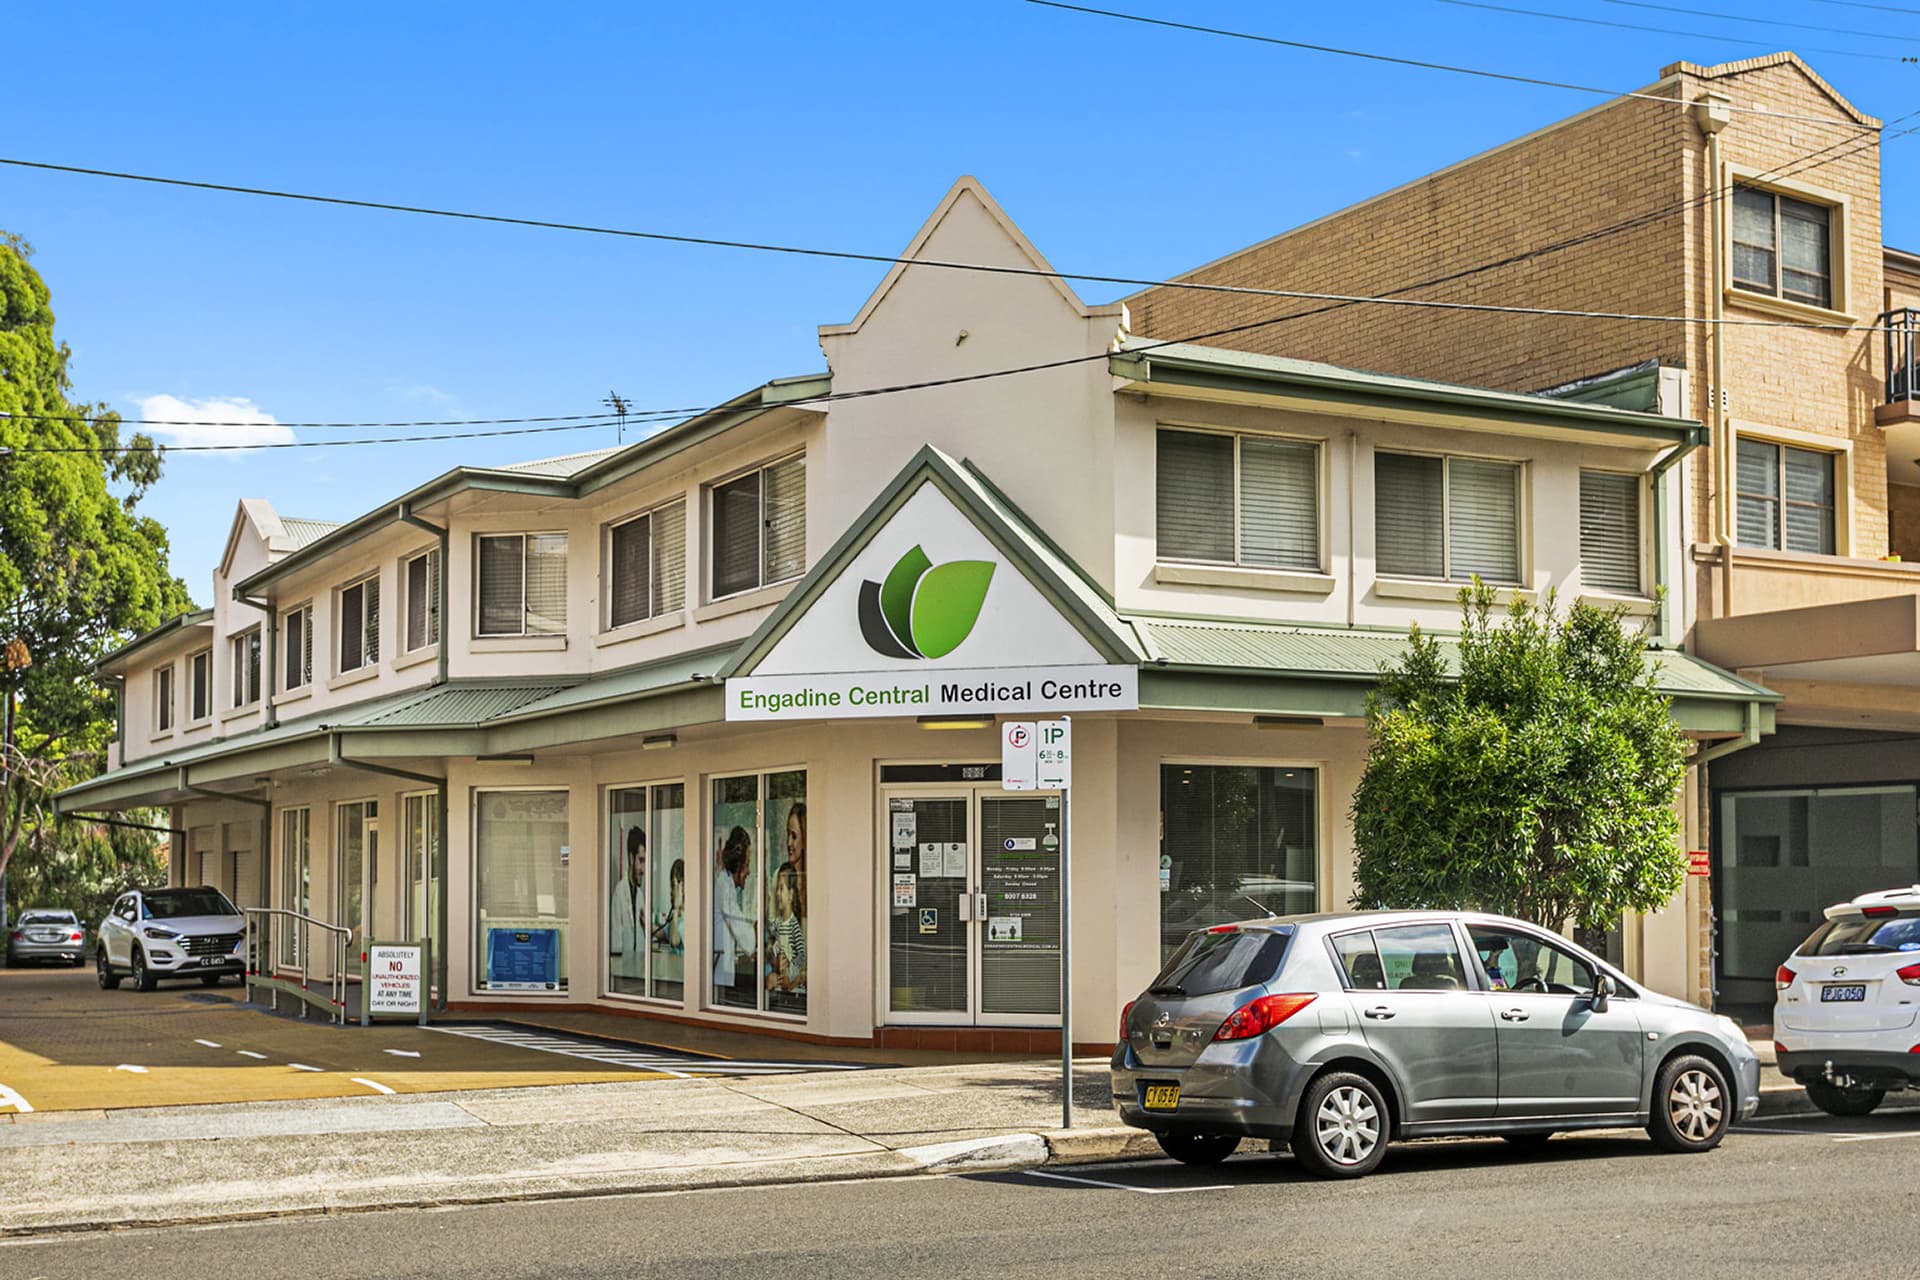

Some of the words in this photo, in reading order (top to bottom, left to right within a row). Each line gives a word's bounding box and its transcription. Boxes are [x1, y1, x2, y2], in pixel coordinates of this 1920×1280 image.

[740, 688, 841, 713] Engadine
[848, 684, 930, 706] Central
[940, 681, 1032, 703] Medical
[1041, 678, 1122, 700] Centre
[1044, 728, 1064, 744] 1P
[377, 951, 414, 959] ABSOLUTELY
[389, 961, 403, 972] NO
[377, 990, 384, 998] AT
[385, 990, 398, 998] ANY
[399, 990, 413, 998] TIME
[397, 1000, 417, 1008] NIGHT
